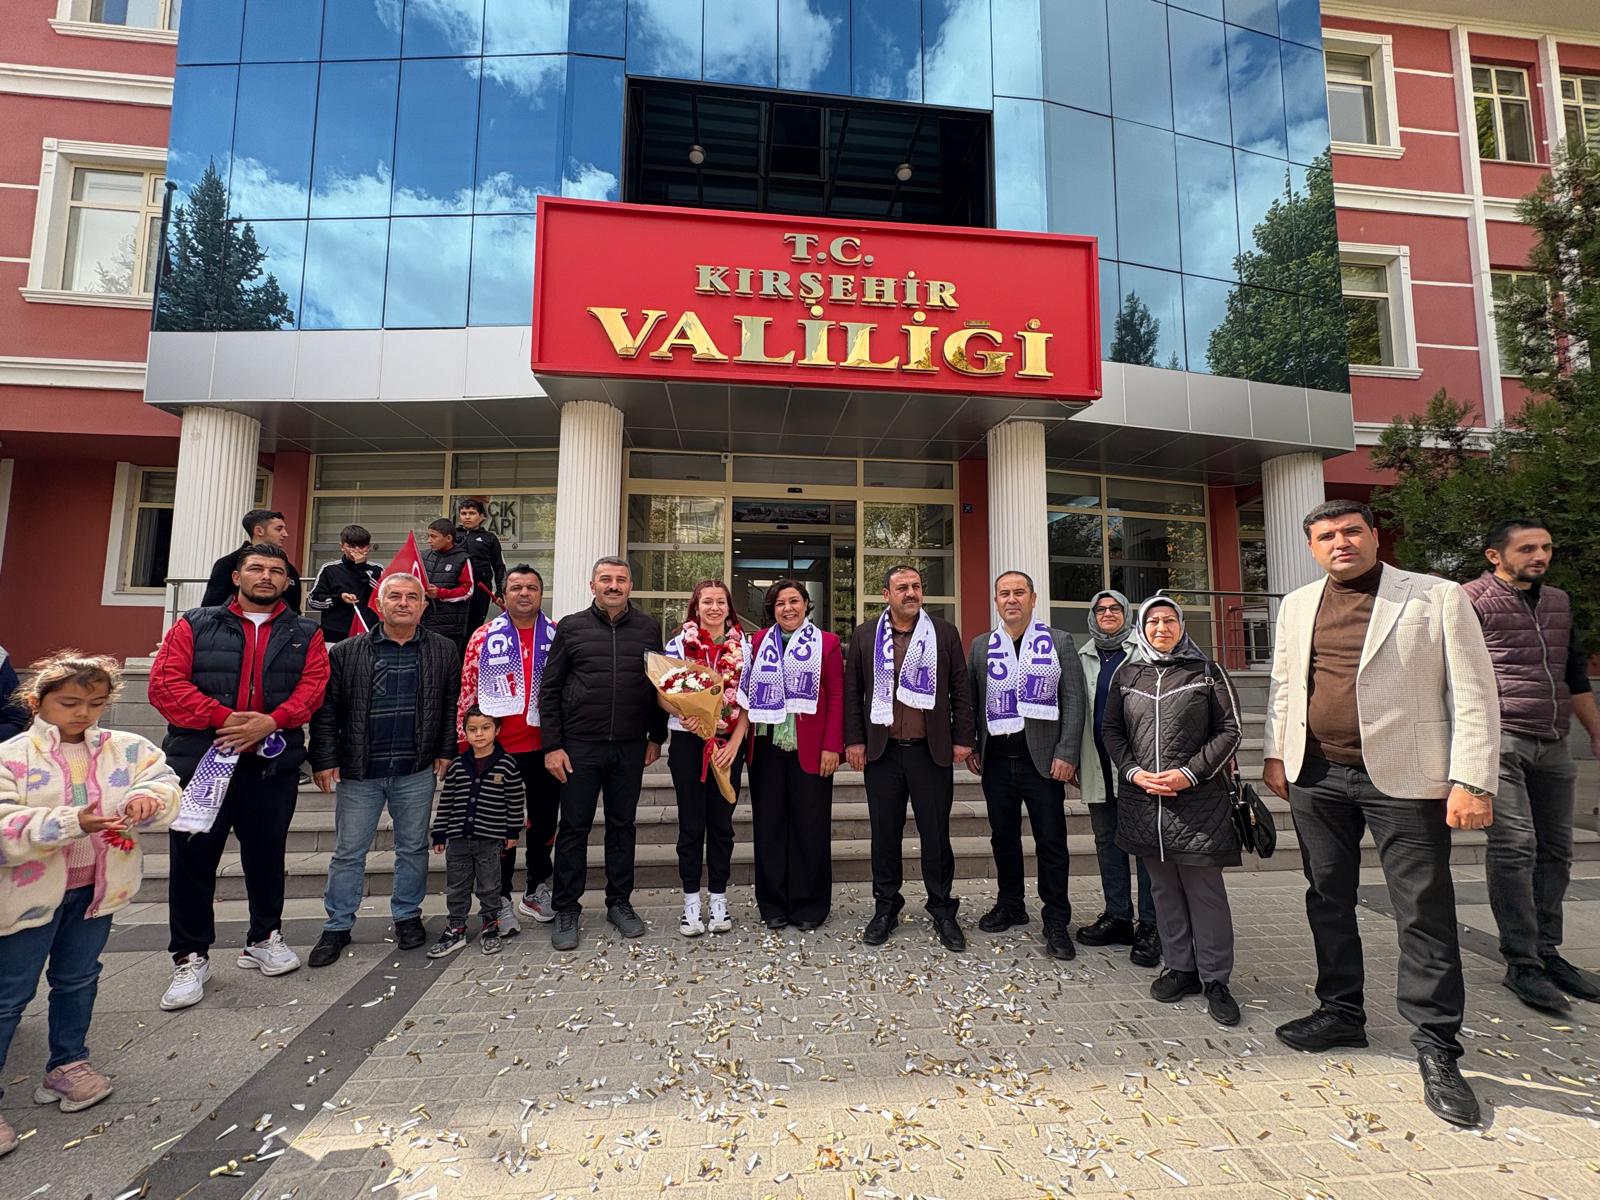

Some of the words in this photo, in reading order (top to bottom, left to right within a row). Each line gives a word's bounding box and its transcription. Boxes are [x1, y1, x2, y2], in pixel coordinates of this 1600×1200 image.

[784, 232, 874, 267] T.C.
[695, 264, 959, 310] KIRŞEHİR
[586, 305, 1054, 380] VALİLİĞİ
